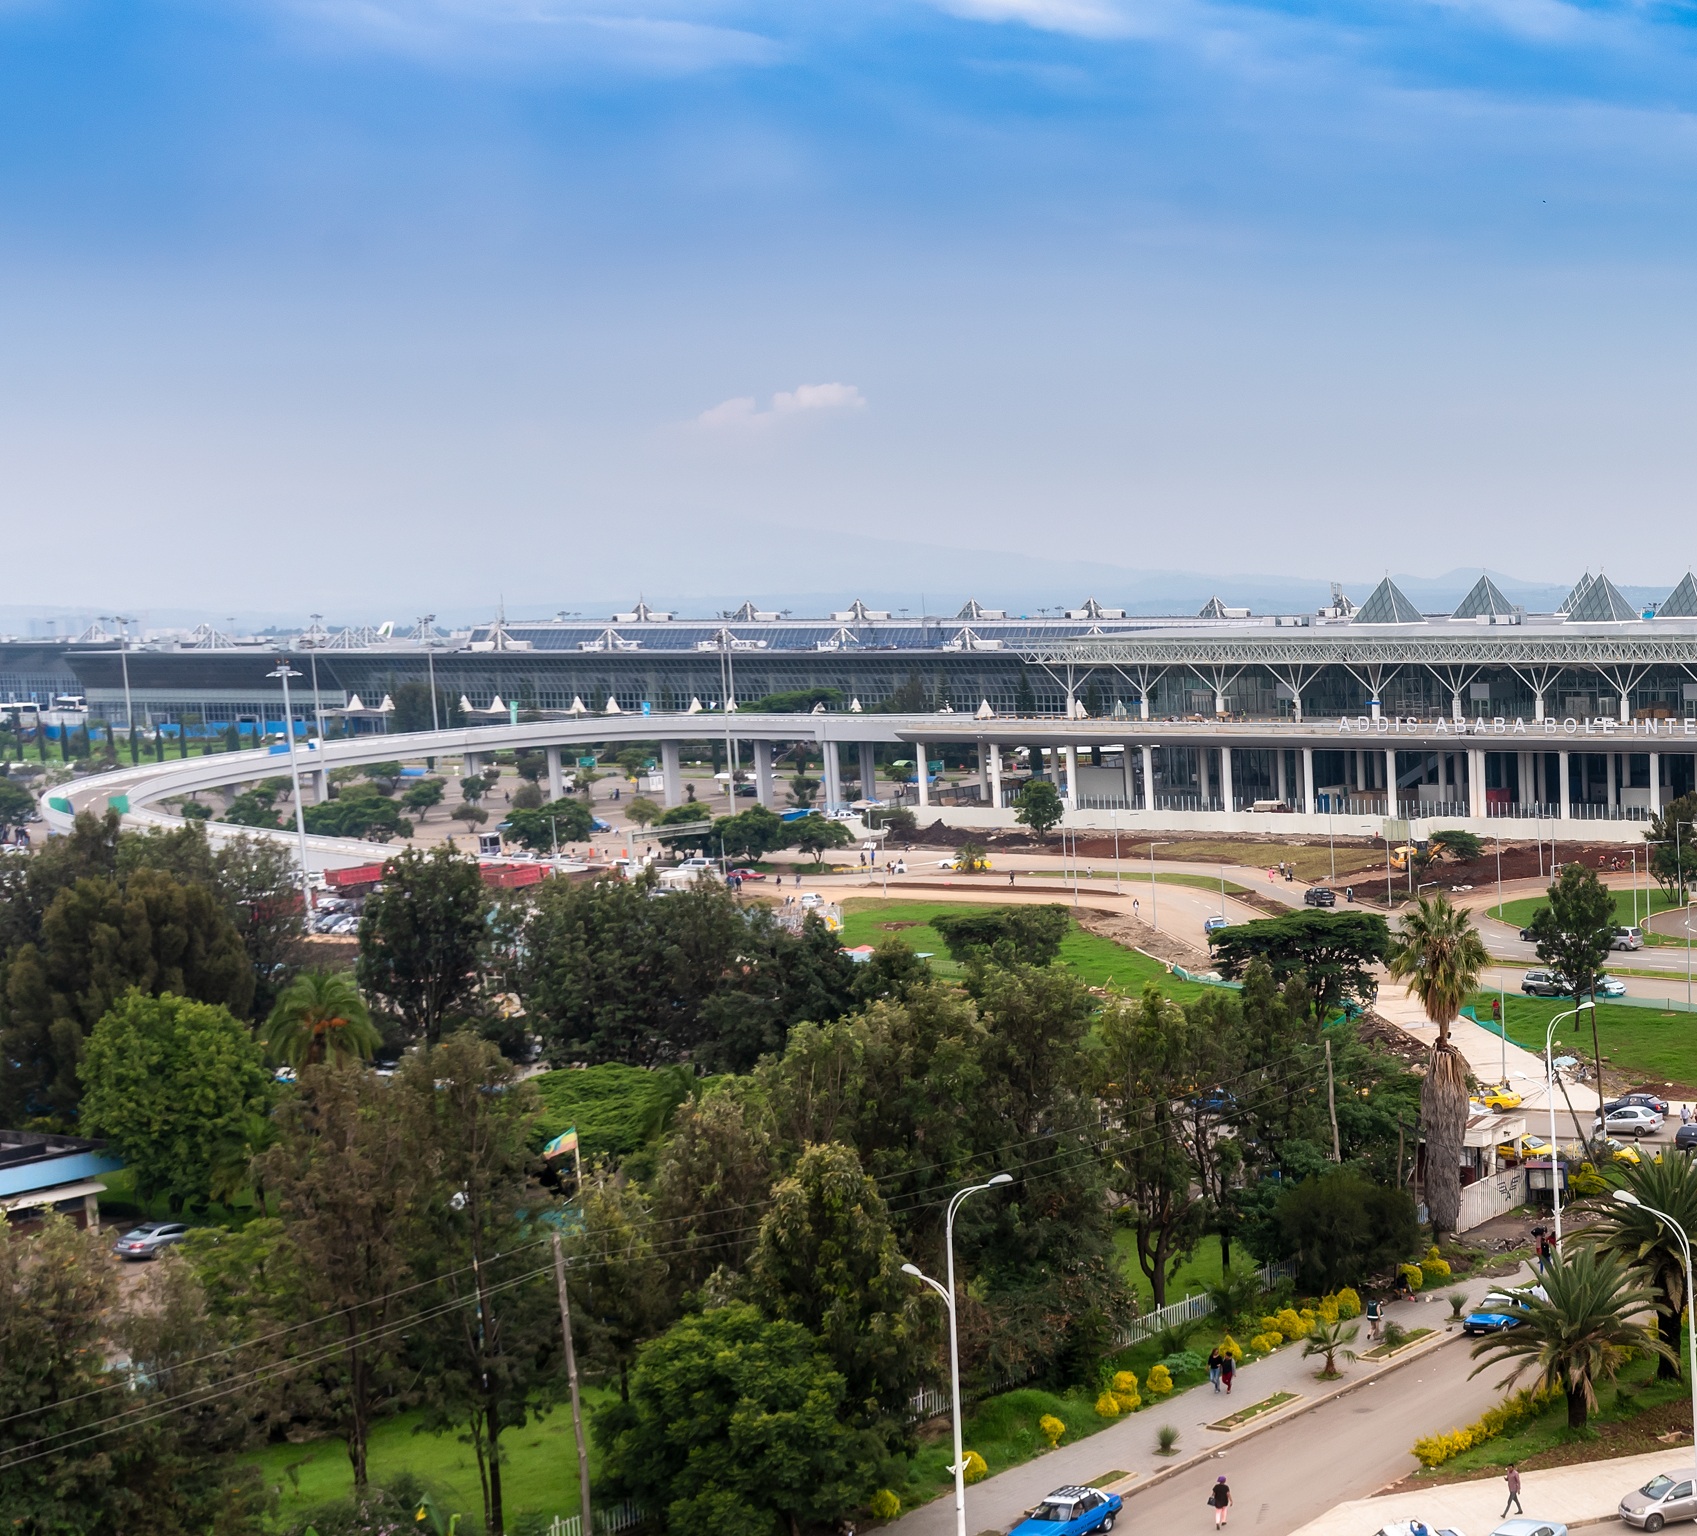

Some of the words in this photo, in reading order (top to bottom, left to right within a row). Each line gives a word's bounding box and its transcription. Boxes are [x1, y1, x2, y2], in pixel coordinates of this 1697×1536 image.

[1339, 715, 1418, 732] ADDIS
[1435, 716, 1526, 733] ABABA
[1544, 717, 1615, 734] BOLE
